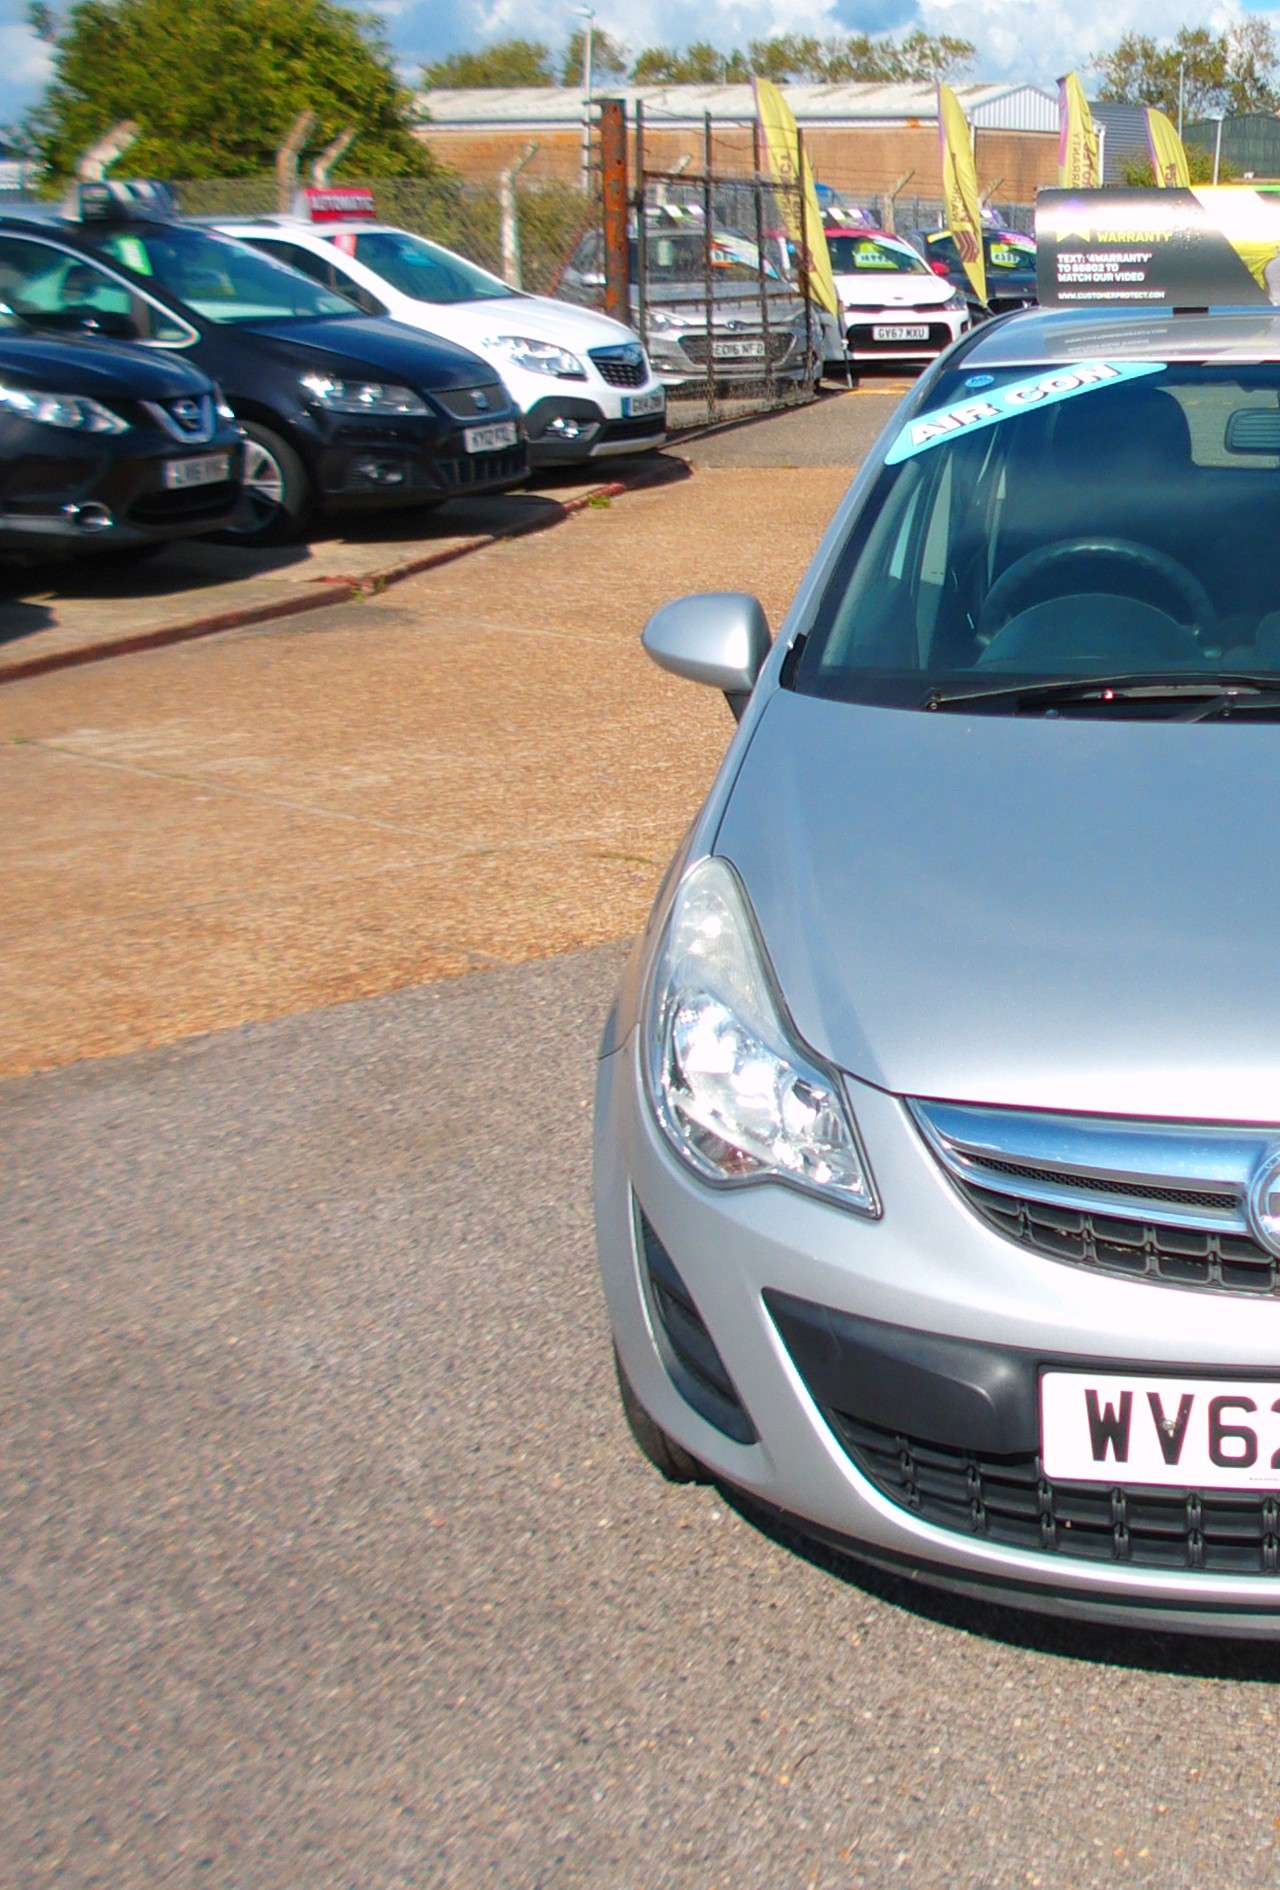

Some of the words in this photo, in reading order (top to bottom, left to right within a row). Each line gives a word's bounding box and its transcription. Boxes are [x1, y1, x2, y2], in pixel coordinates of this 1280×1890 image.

[1057, 263, 1071, 273] TO
[1106, 263, 1119, 273] TO
[1057, 273, 1092, 282] WATCH
[1093, 273, 1113, 282] OUR
[1115, 272, 1145, 282] VIDEO
[910, 402, 1001, 446] AIR
[1003, 361, 1122, 405] CON
